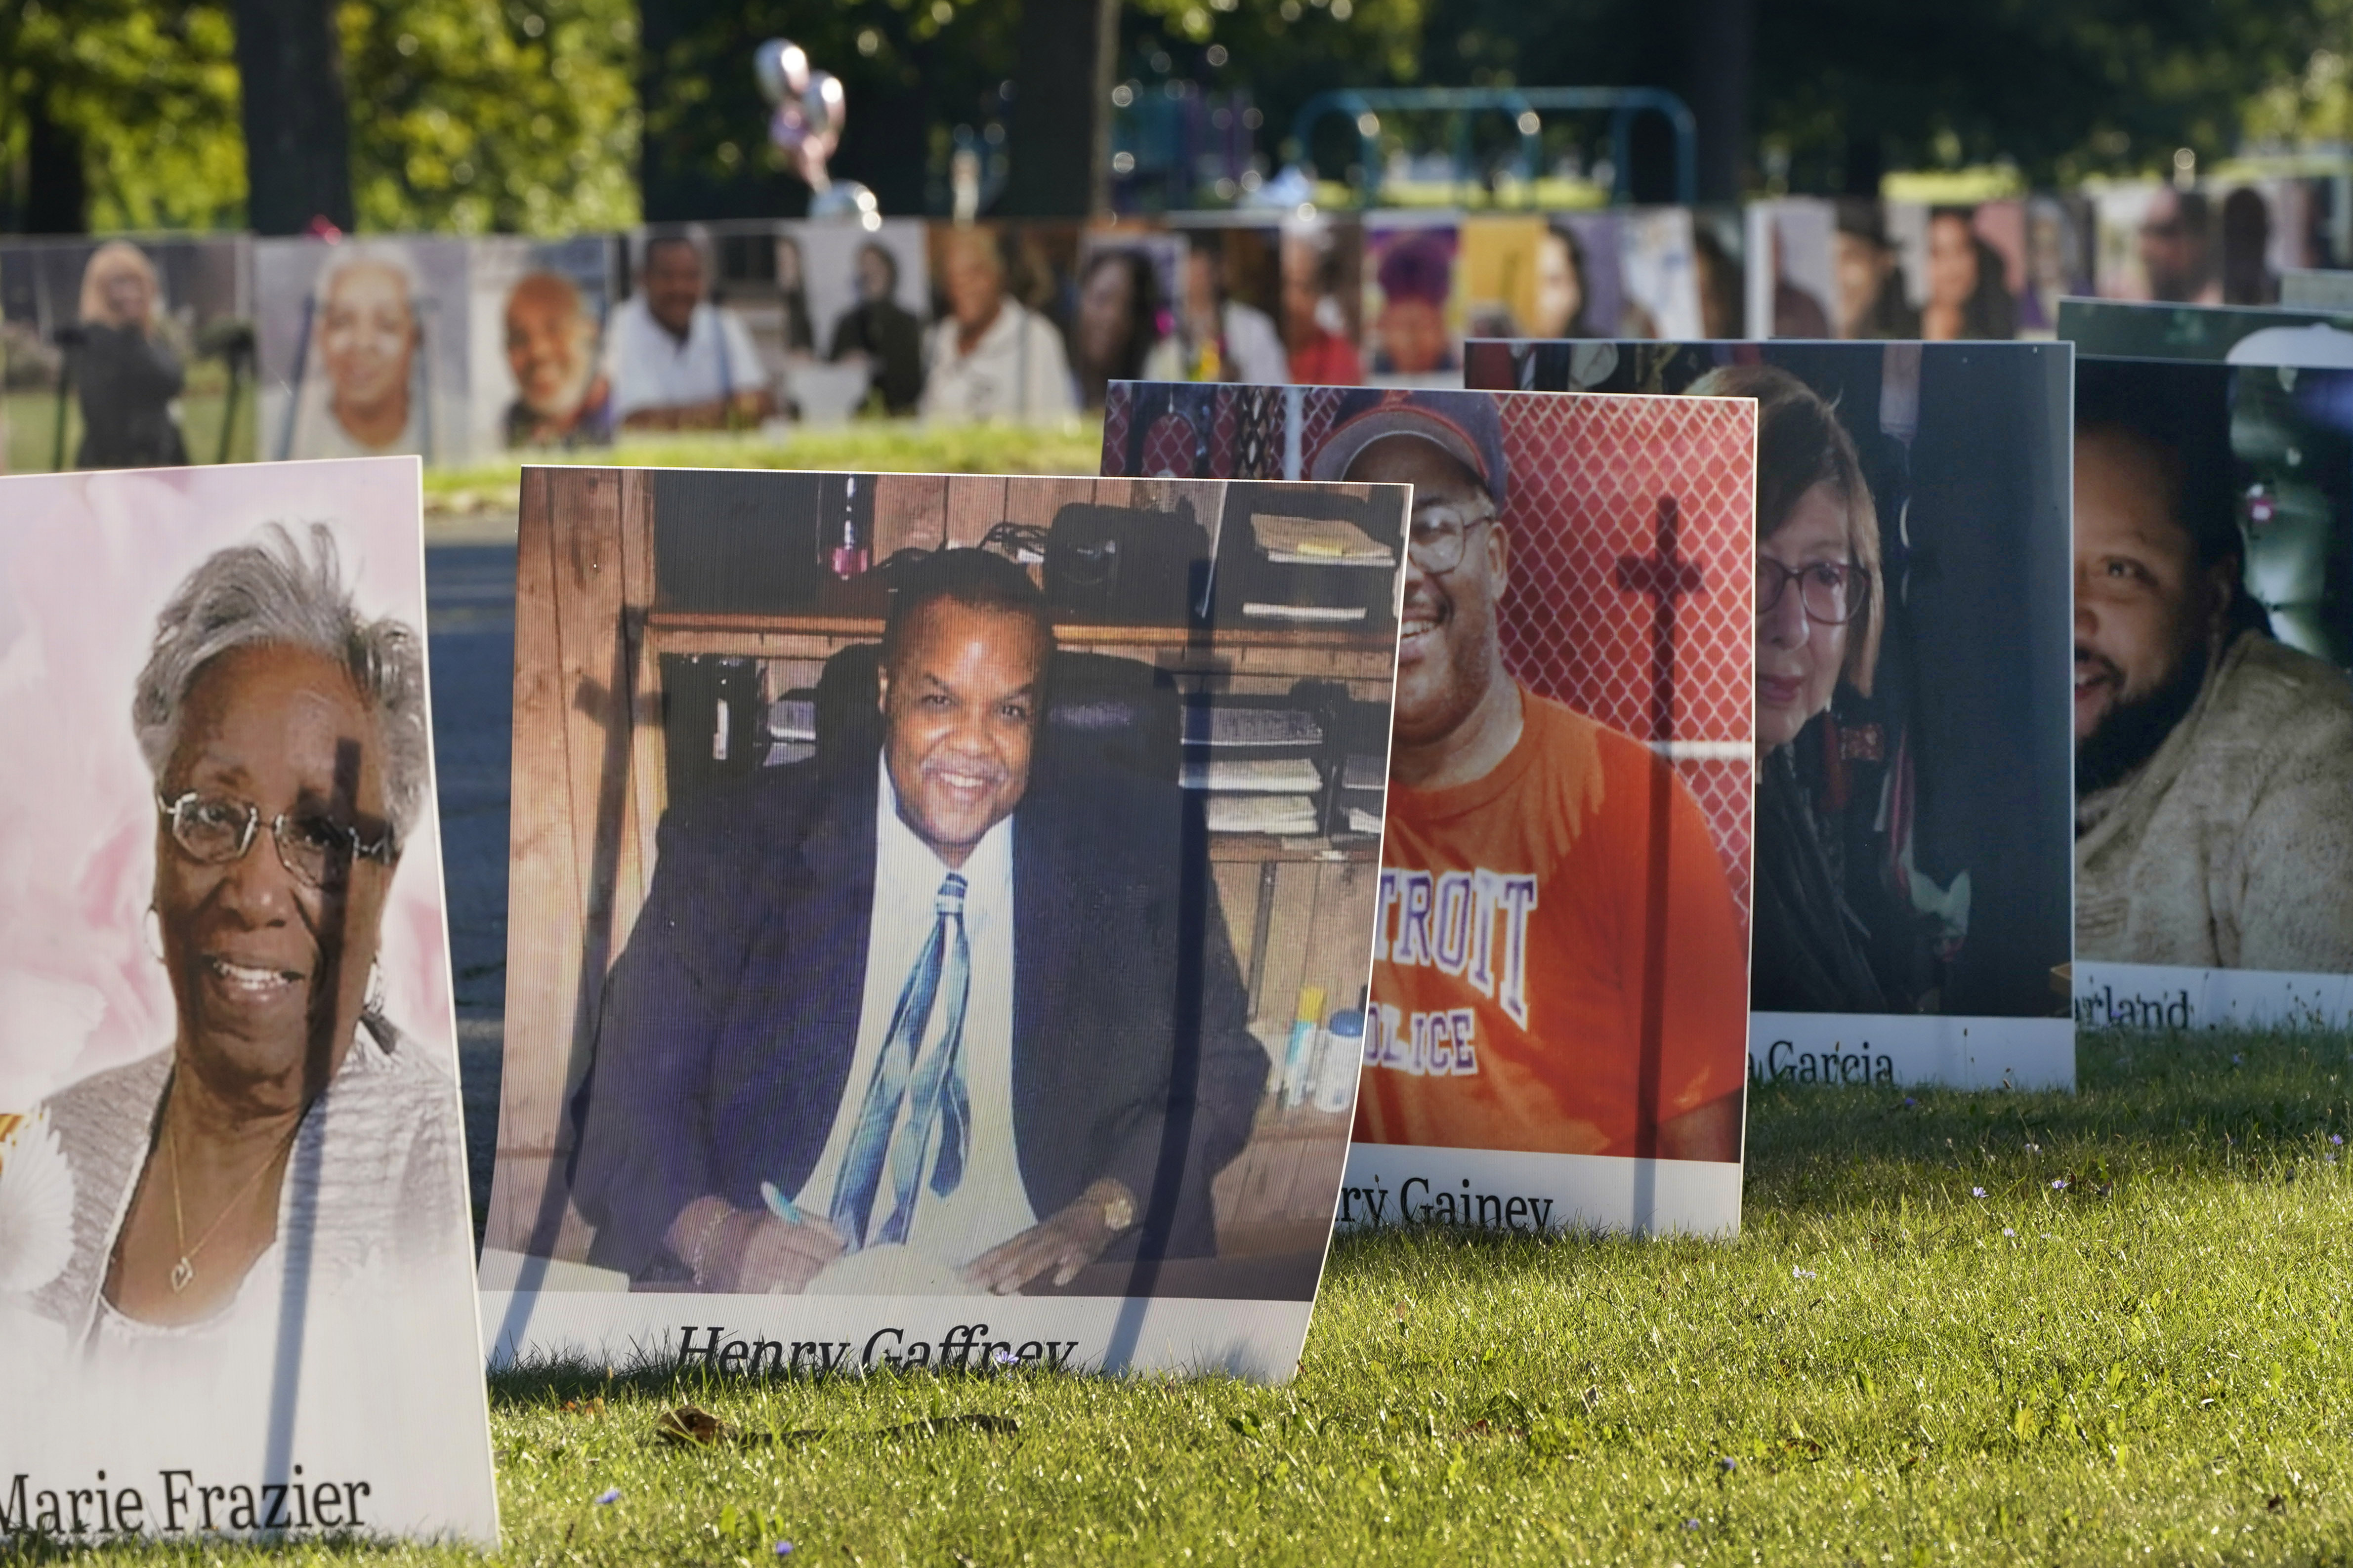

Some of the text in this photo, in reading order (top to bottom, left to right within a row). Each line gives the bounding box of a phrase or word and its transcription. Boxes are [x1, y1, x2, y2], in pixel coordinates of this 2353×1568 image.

[1374, 867, 1538, 1032] TROIT
[1362, 1001, 1478, 1076] OLICE
[1768, 1040, 1894, 1085] Garcia
[1335, 1177, 1554, 1232] ry Gainey
[677, 1323, 1079, 1378] Henry Gaffney
[0, 1464, 371, 1534] Marie Frazier
